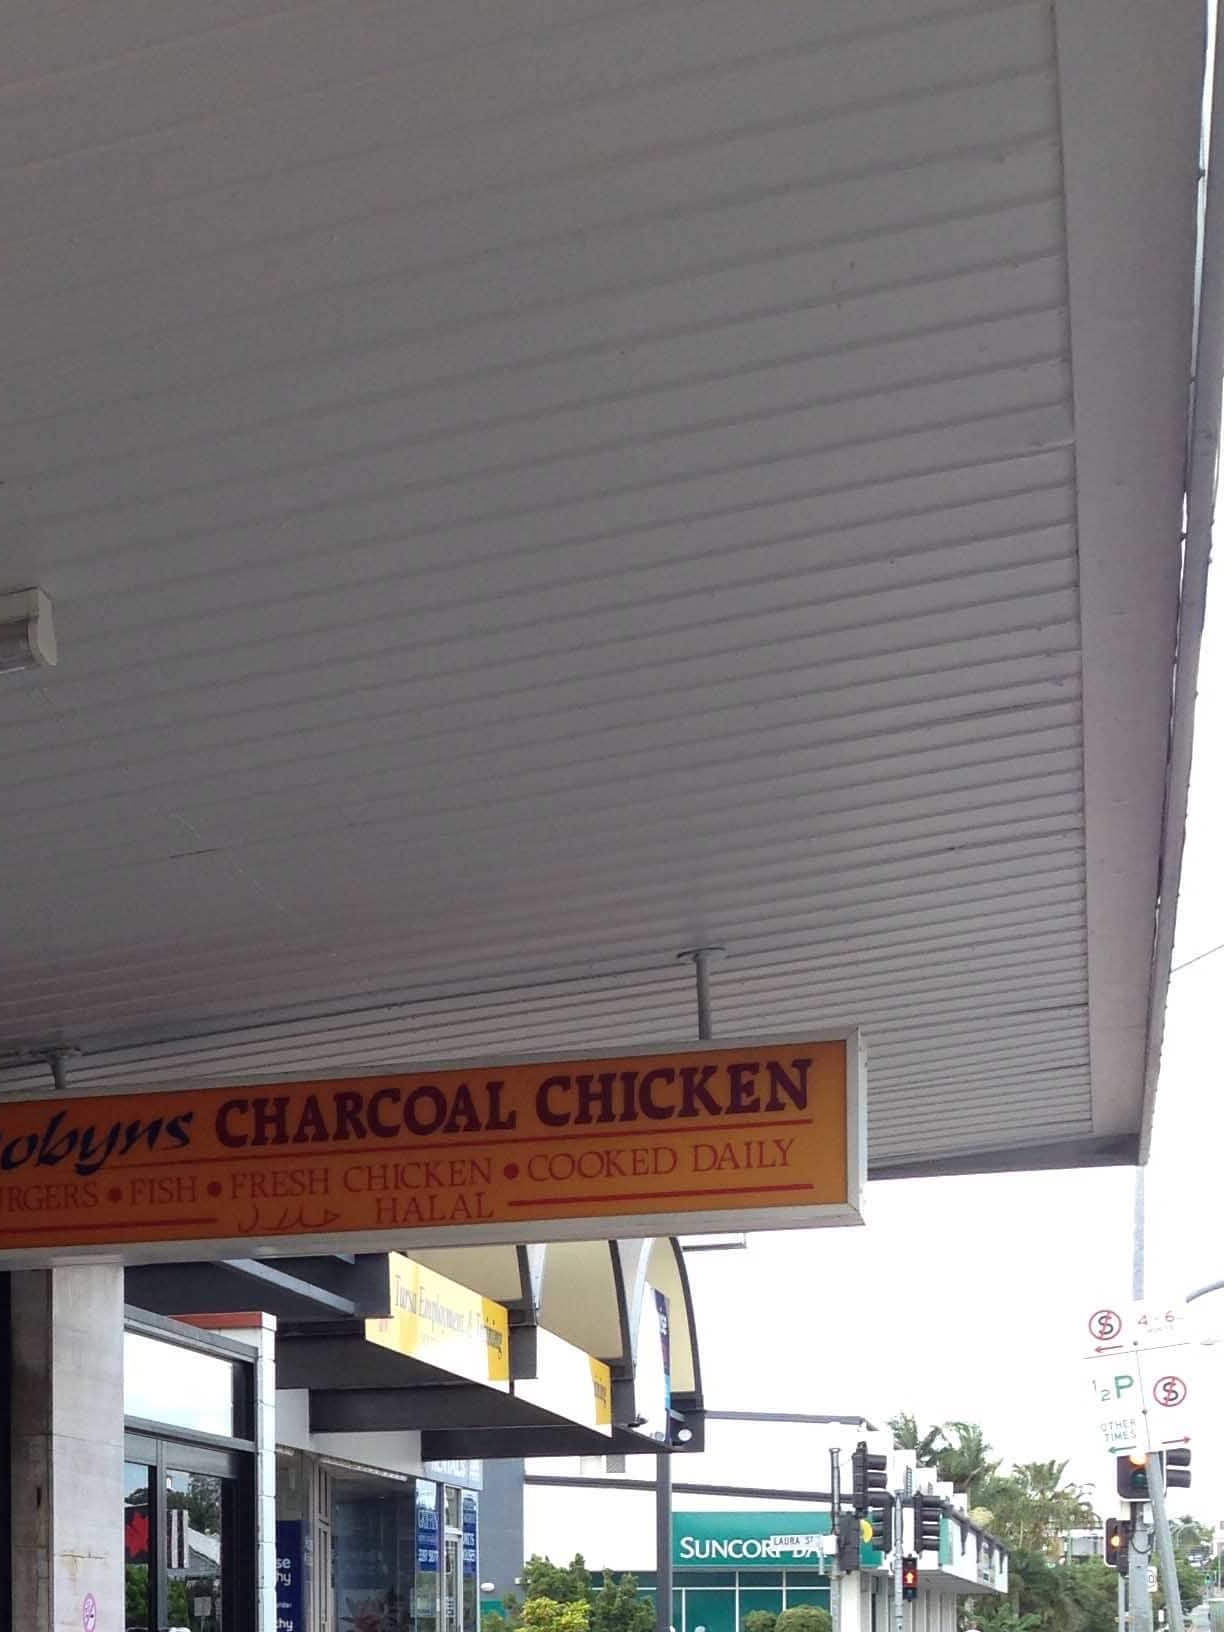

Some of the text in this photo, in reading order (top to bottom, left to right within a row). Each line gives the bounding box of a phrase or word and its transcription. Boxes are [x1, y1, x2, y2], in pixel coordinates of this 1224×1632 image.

[215, 1081, 517, 1148] CHARCOAL
[535, 1058, 814, 1128] CHICKEN
[128, 1175, 200, 1207] FISH
[230, 1168, 329, 1200] FRESH
[343, 1157, 494, 1193] CHICKEN
[527, 1146, 678, 1182] COOKED
[692, 1137, 794, 1173] DAILY
[375, 1192, 495, 1224] HALAL
[1100, 1418, 1136, 1433] OTHER
[1104, 1430, 1137, 1442] TIMES
[679, 1536, 782, 1560] SUNCOR
